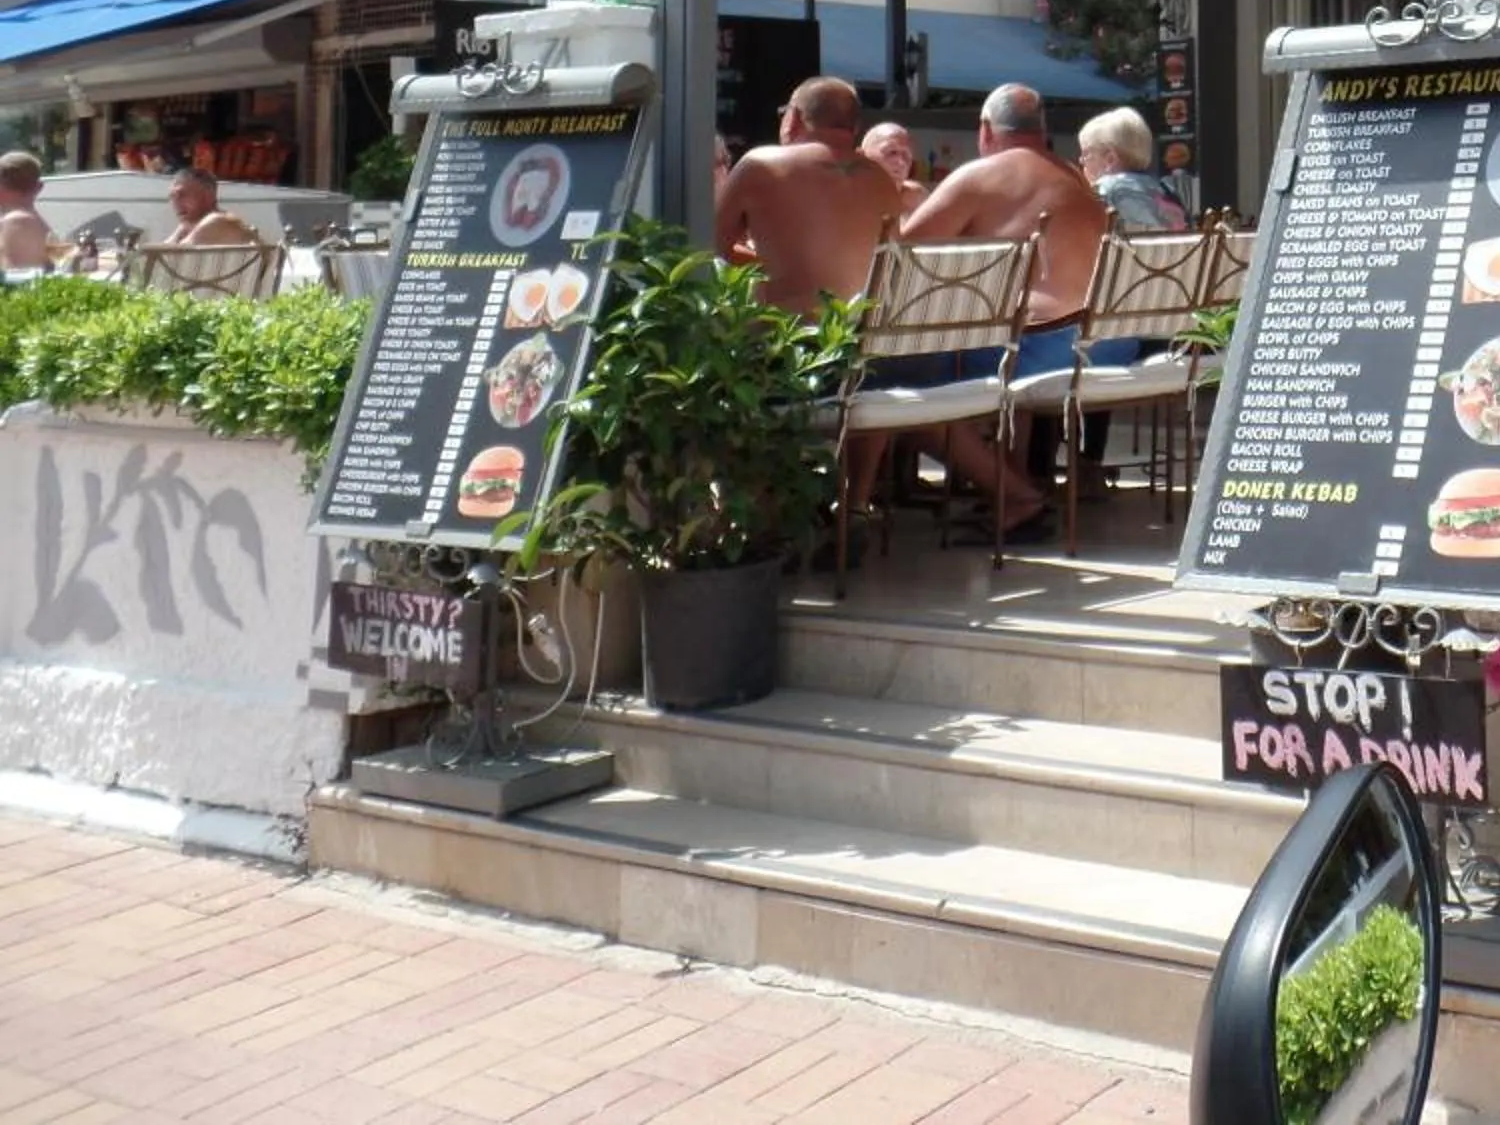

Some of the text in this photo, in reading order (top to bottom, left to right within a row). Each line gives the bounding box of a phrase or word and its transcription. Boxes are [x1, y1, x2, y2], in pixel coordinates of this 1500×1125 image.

[1320, 75, 1400, 103] ANDY'S
[1357, 108, 1417, 123] BREAKFAST
[549, 113, 627, 134] BREAKFAST
[1353, 122, 1413, 136] BREAKFAST
[1350, 152, 1386, 165] TOAST
[1355, 166, 1392, 179] TOAST
[1334, 181, 1377, 194] TOASTY
[1383, 193, 1420, 206] TOAST
[1408, 207, 1447, 221] TOAST
[1380, 223, 1423, 237] TOASTY
[1389, 238, 1427, 252] TOAST
[459, 252, 529, 267] BREAKFAST
[1367, 254, 1400, 267] CHIPS
[1335, 286, 1368, 299] CHIPS
[1265, 302, 1305, 314] BACON
[1373, 300, 1407, 313] CHIPS
[1382, 316, 1416, 330] CHIPS
[1307, 332, 1340, 345] CHIPS
[1254, 348, 1286, 361] CHIPS
[1250, 363, 1361, 377] CHICKEN SANDWICH
[1275, 379, 1336, 393] SANDWICH
[1243, 395, 1287, 408] BURGER
[1315, 395, 1349, 409] CHIPS
[1239, 411, 1280, 424] CHEESE
[1281, 411, 1326, 425] BURGER
[1355, 413, 1390, 427] CHIPS
[1235, 427, 1284, 440] CHICKEN
[1285, 428, 1330, 442] BURGER
[1359, 429, 1393, 444] CHIPS
[1231, 442, 1272, 456] BACON
[1227, 459, 1304, 474] CHEESE WRAP
[1222, 480, 1359, 503] DONER KEBAB
[1213, 518, 1262, 532] CHICKEN
[1208, 534, 1241, 548] LAMB
[1203, 551, 1228, 565] MIX
[340, 615, 463, 664] WELCOME
[1232, 720, 1484, 801] FOR A DRINK
